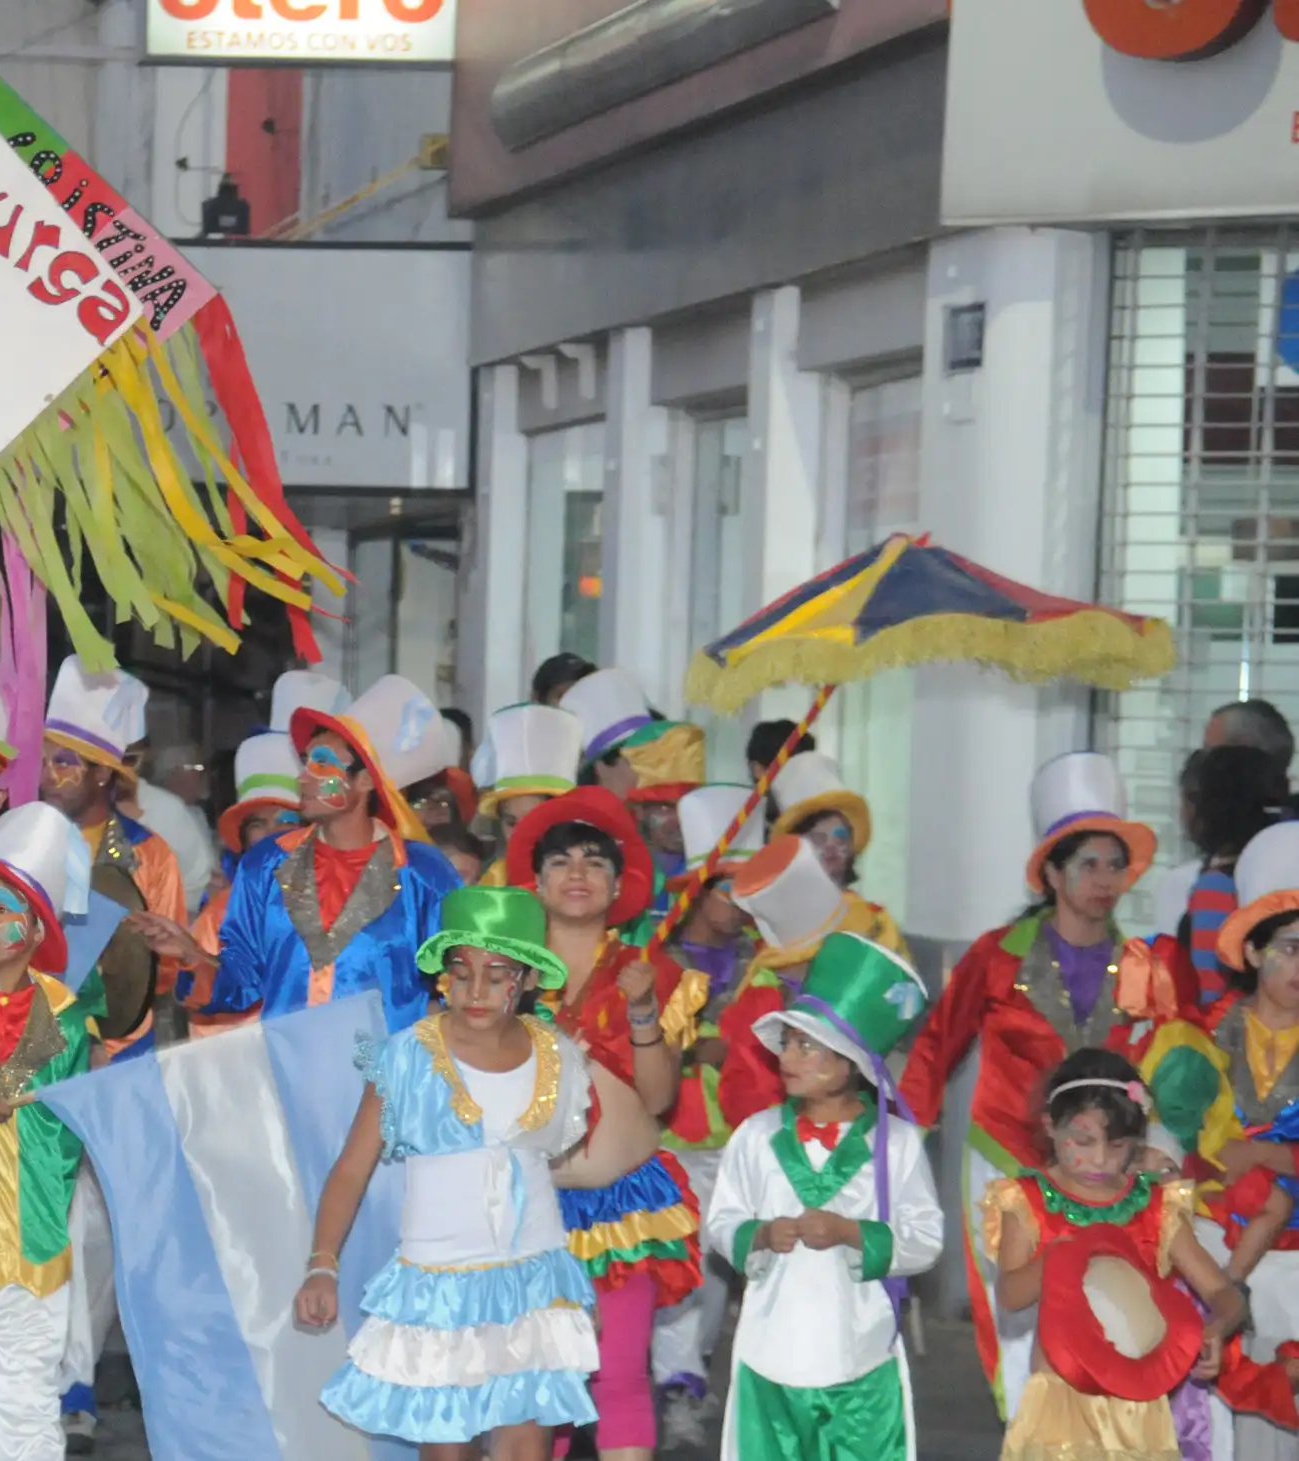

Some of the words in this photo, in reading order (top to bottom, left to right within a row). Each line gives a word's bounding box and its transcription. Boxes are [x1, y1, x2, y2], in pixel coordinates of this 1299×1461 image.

[186, 30, 298, 50] ESTAMOS
[306, 33, 357, 51] CON
[366, 34, 413, 51] VOS
